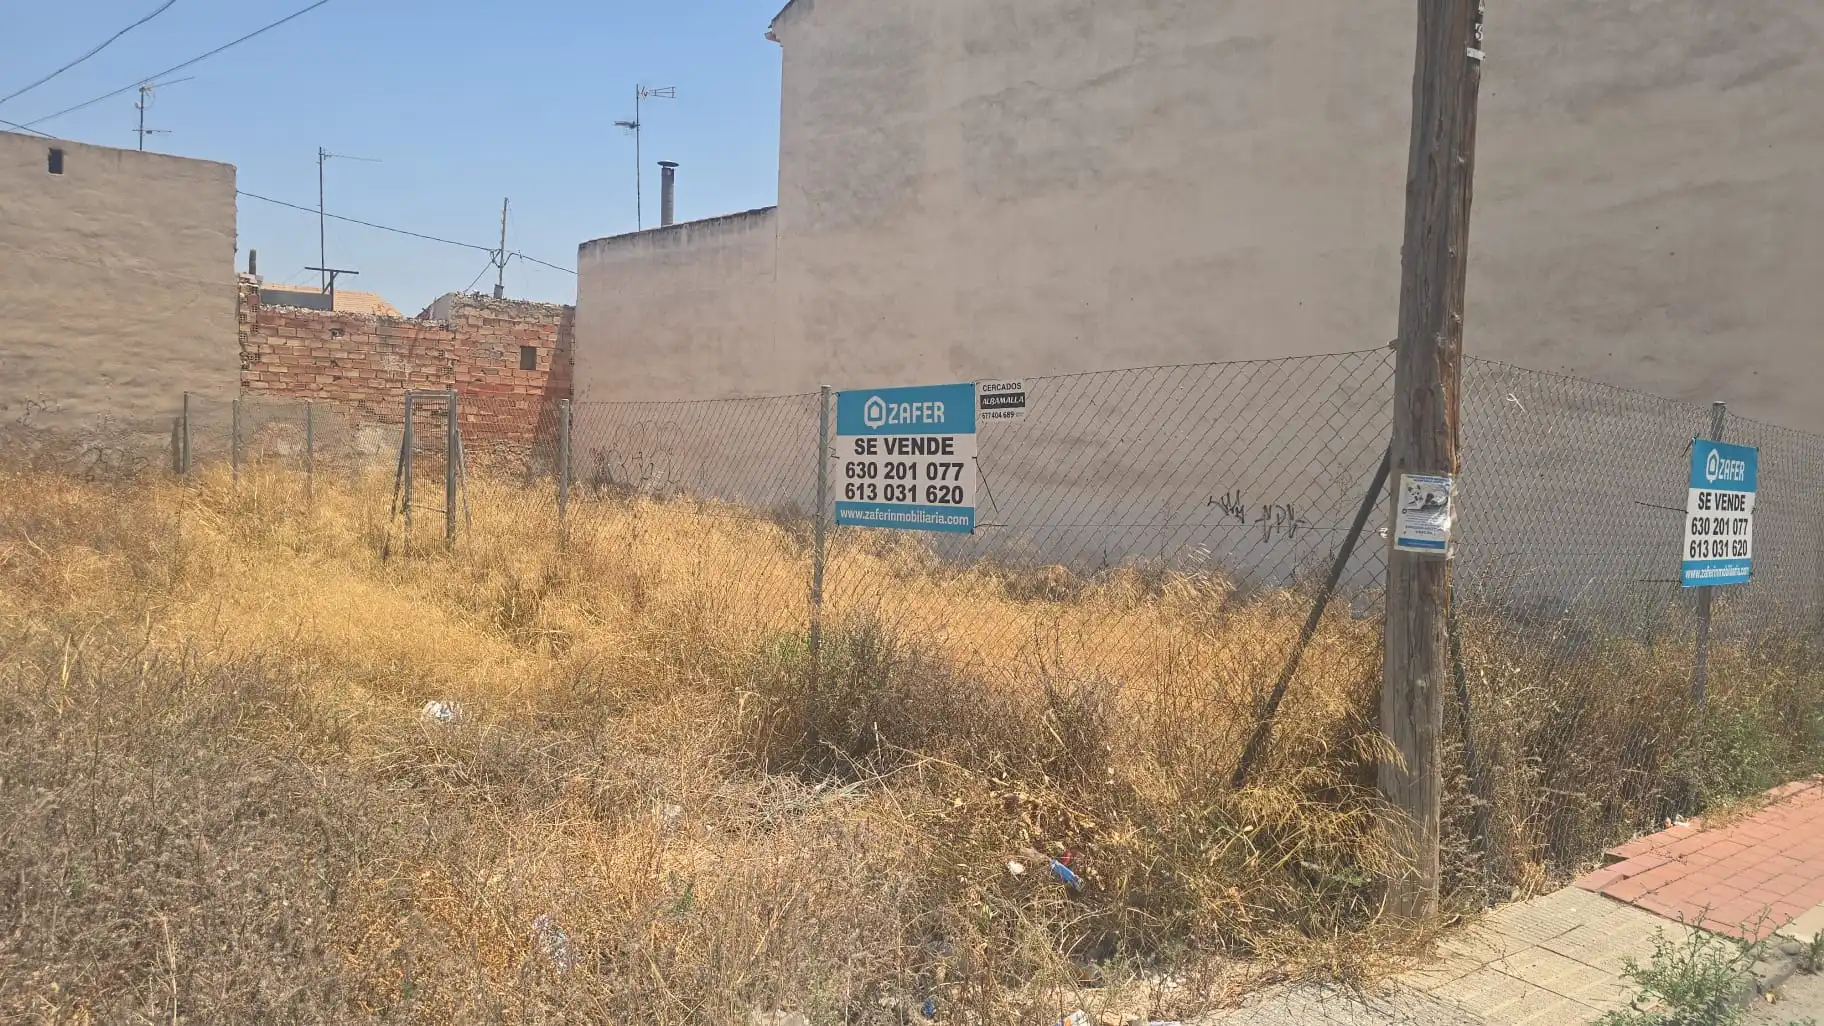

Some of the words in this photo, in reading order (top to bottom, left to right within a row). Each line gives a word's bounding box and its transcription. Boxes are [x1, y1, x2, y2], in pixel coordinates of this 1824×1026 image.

[982, 382, 1022, 391] CERCADOS
[888, 401, 945, 425] ZAFER
[991, 411, 1002, 419] 404
[854, 437, 877, 456] SE
[883, 437, 954, 456] VENDE
[845, 461, 878, 479] 630
[884, 461, 917, 480] 201
[926, 462, 964, 481] 077
[1719, 459, 1745, 481] ZAFER
[845, 482, 878, 501] 613
[883, 483, 917, 502] 031
[925, 485, 964, 504] 620
[1698, 492, 1712, 511] SE
[1714, 493, 1746, 512] VENDE
[840, 508, 969, 526] www.zaferinmobiliaria.com
[1691, 517, 1710, 535] 630
[1712, 517, 1729, 535] 201
[1732, 518, 1748, 535] 077
[1689, 540, 1709, 558] 613
[1712, 540, 1729, 557] 031
[1732, 539, 1748, 557] 620
